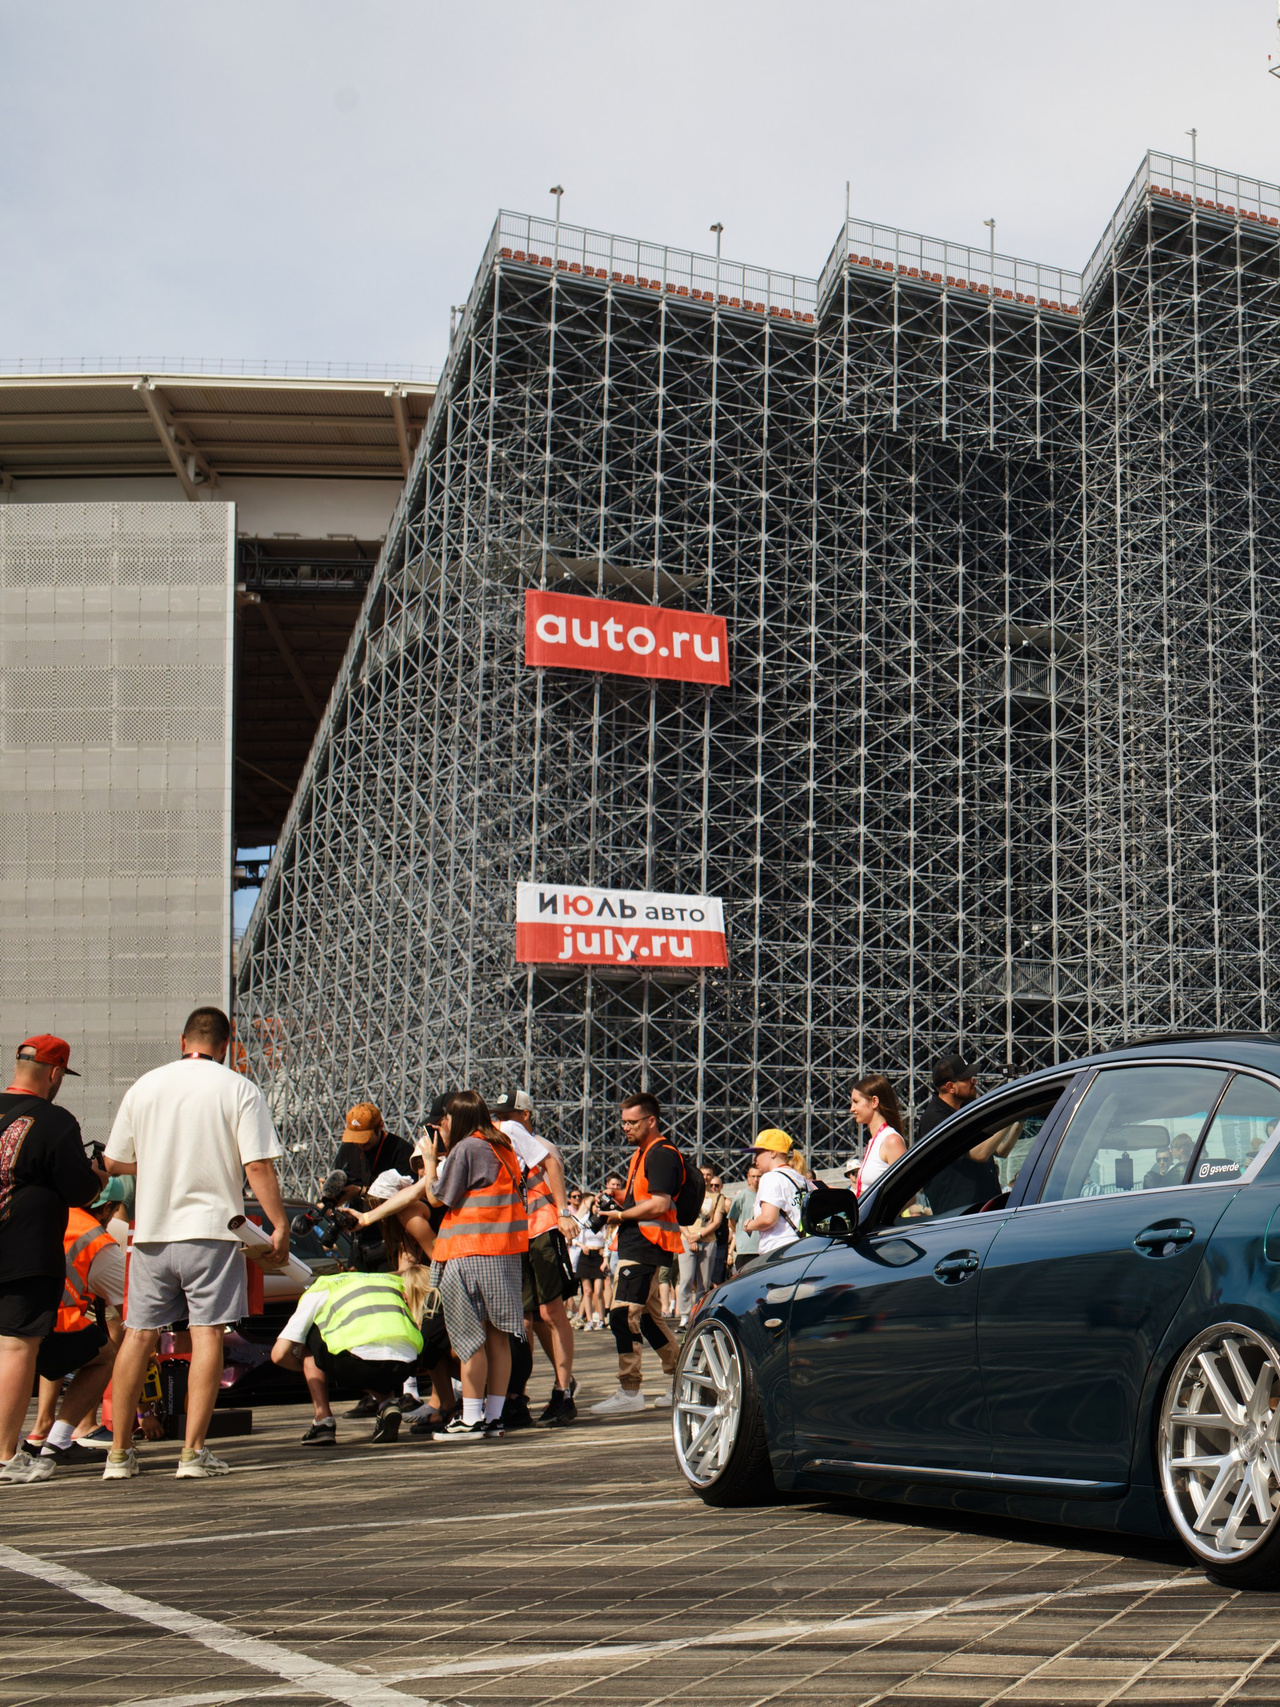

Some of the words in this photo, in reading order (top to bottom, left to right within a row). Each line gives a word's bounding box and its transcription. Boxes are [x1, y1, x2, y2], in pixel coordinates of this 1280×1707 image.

[535, 614, 720, 663] auto.ru
[538, 891, 637, 920] ИЮЛЬ
[558, 925, 693, 962] july.ru
[1209, 1162, 1239, 1175] gsverde
